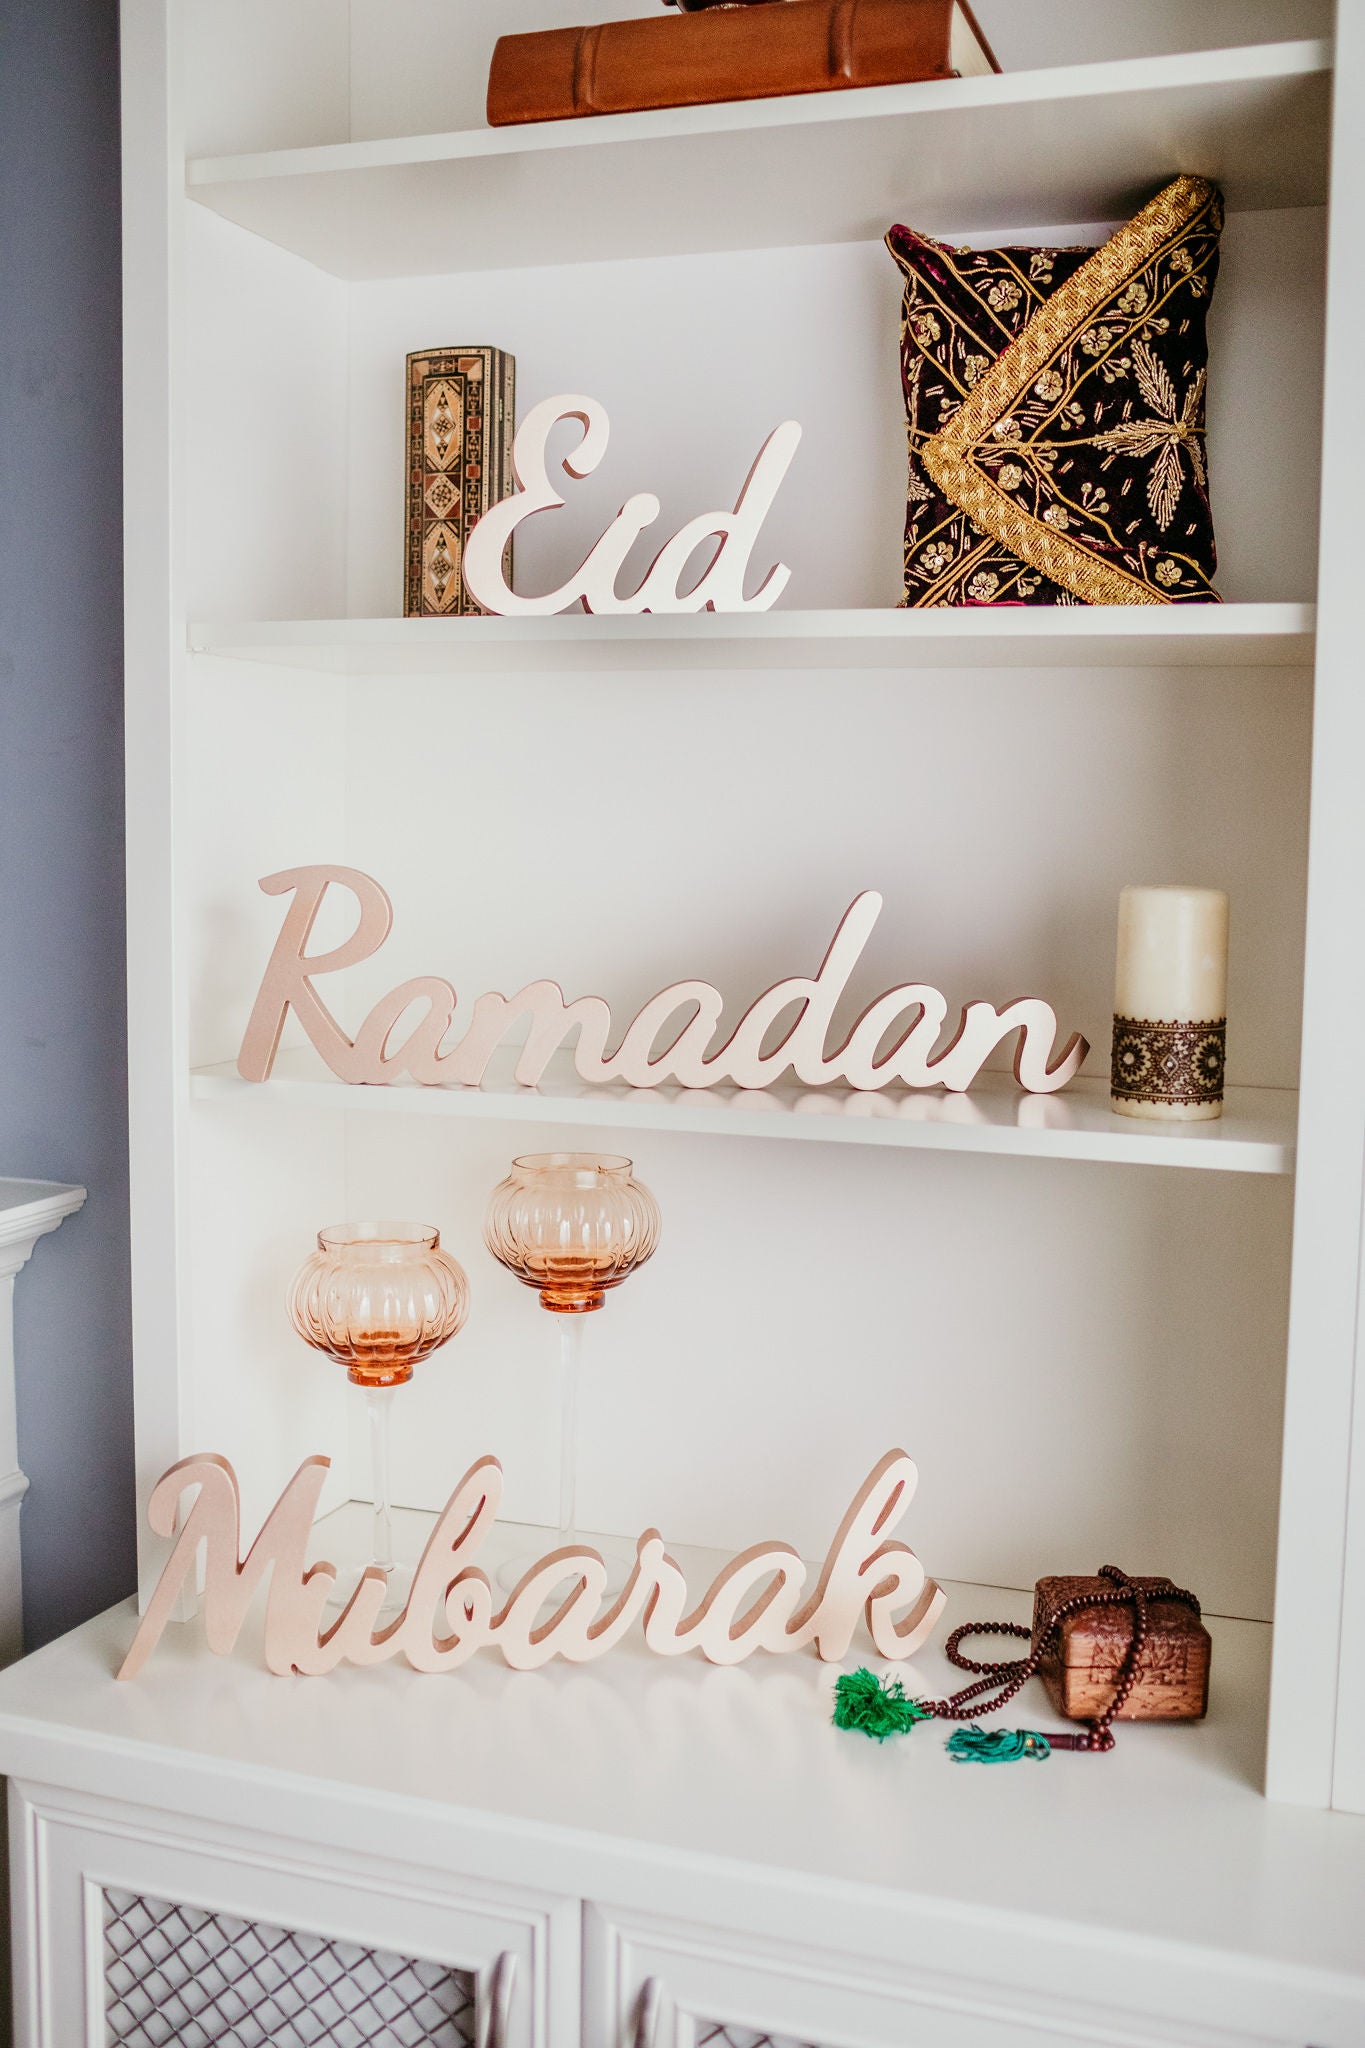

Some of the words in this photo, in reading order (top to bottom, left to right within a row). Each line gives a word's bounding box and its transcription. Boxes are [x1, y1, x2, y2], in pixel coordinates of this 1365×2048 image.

[462, 394, 802, 616] Eid
[236, 864, 1090, 1093] Ramadan
[116, 1447, 948, 1678] Mubarak
